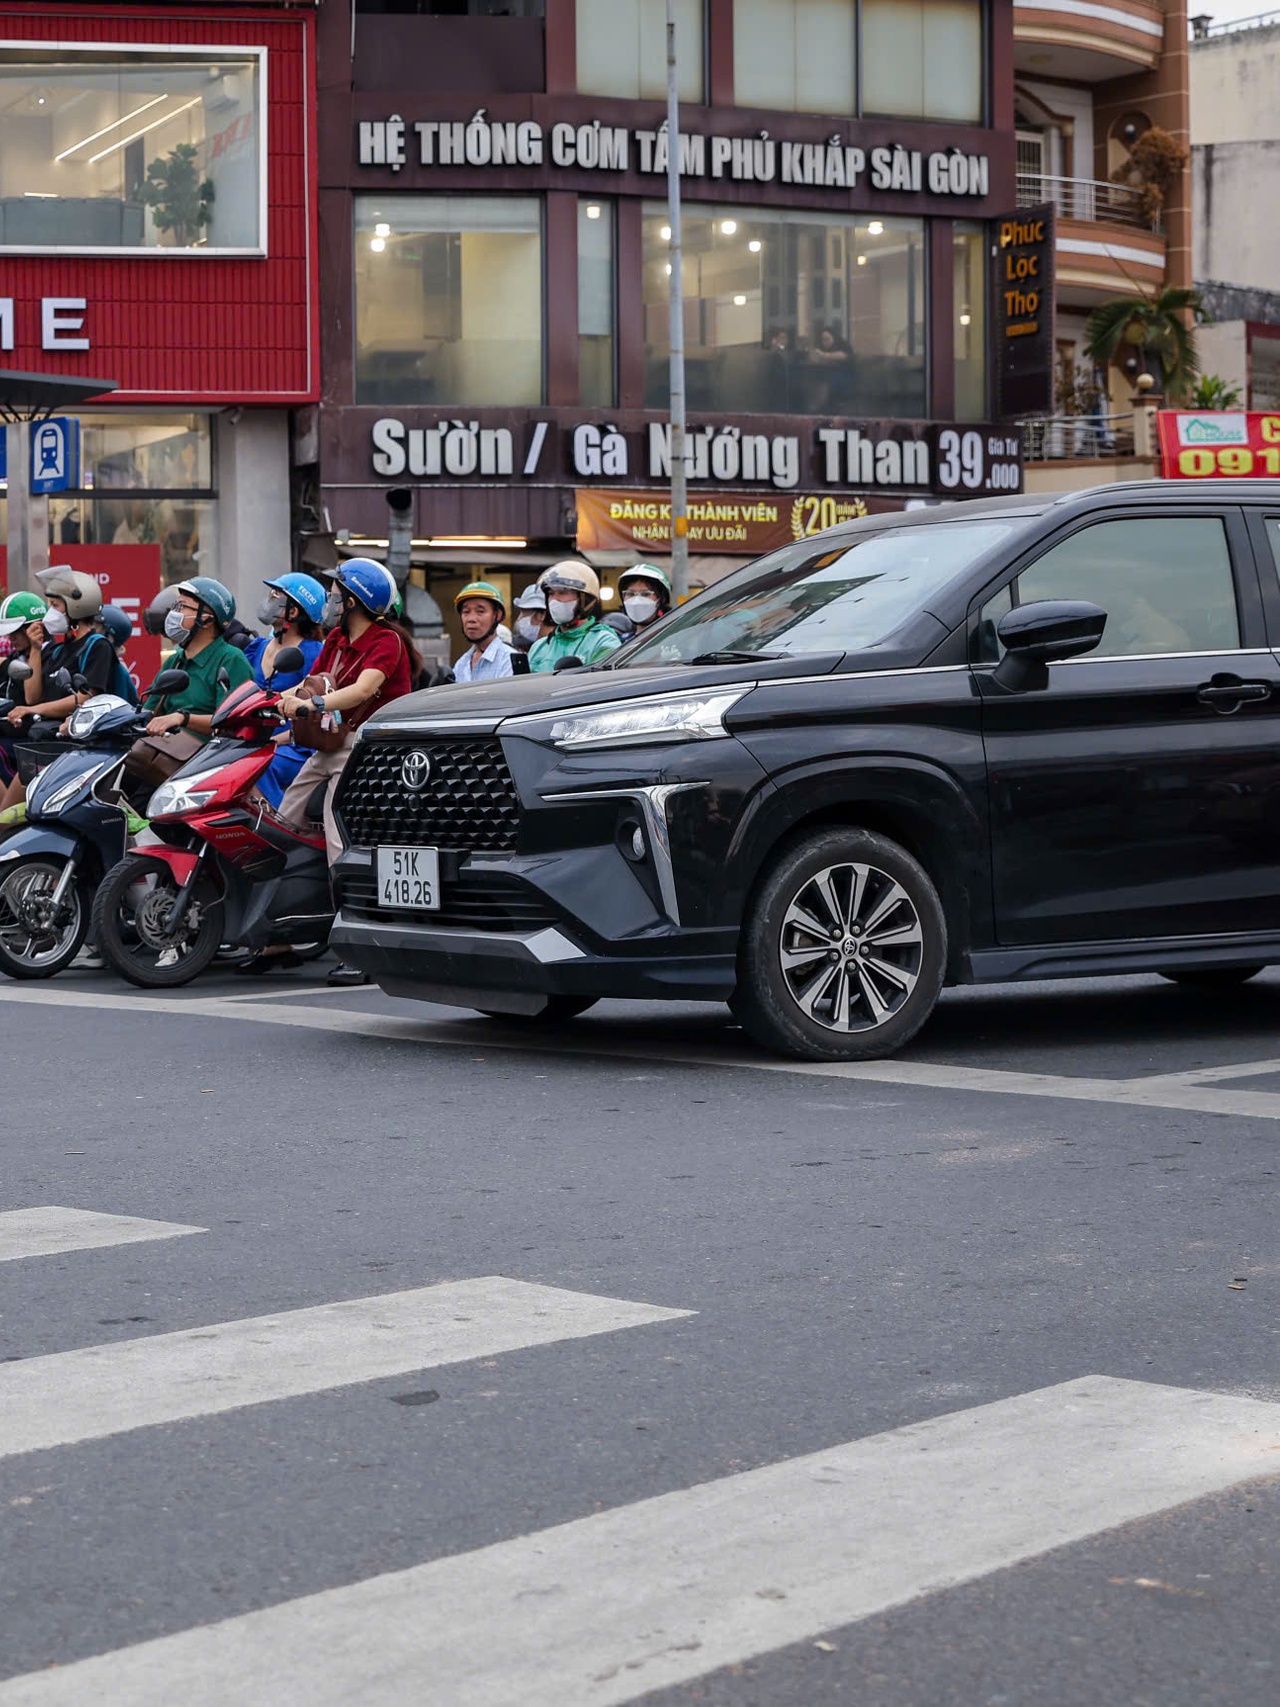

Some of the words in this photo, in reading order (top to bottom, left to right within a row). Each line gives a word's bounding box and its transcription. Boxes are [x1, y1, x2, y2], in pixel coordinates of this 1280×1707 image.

[359, 114, 406, 171] HỆ
[415, 109, 543, 165] THỐNG
[551, 120, 629, 170] CƠM
[712, 130, 774, 181] PHỦ
[782, 134, 865, 187] KHẮP
[871, 144, 921, 191] SÀI
[928, 147, 989, 196] GÒN
[1000, 218, 1044, 248] Phúc
[1006, 253, 1038, 283] Lộc
[372, 418, 513, 476] Sườn
[573, 423, 628, 476] Gà
[819, 429, 929, 485] Than
[939, 429, 983, 488] 39
[610, 500, 658, 520] ĐĂNG
[686, 502, 739, 521] THÀNH
[741, 502, 778, 522] VIÊN
[805, 497, 836, 535] 20
[632, 522, 669, 541] NHẬN
[215, 832, 246, 840] HONDA
[393, 851, 419, 876] 51K
[384, 879, 432, 906] 418.26
